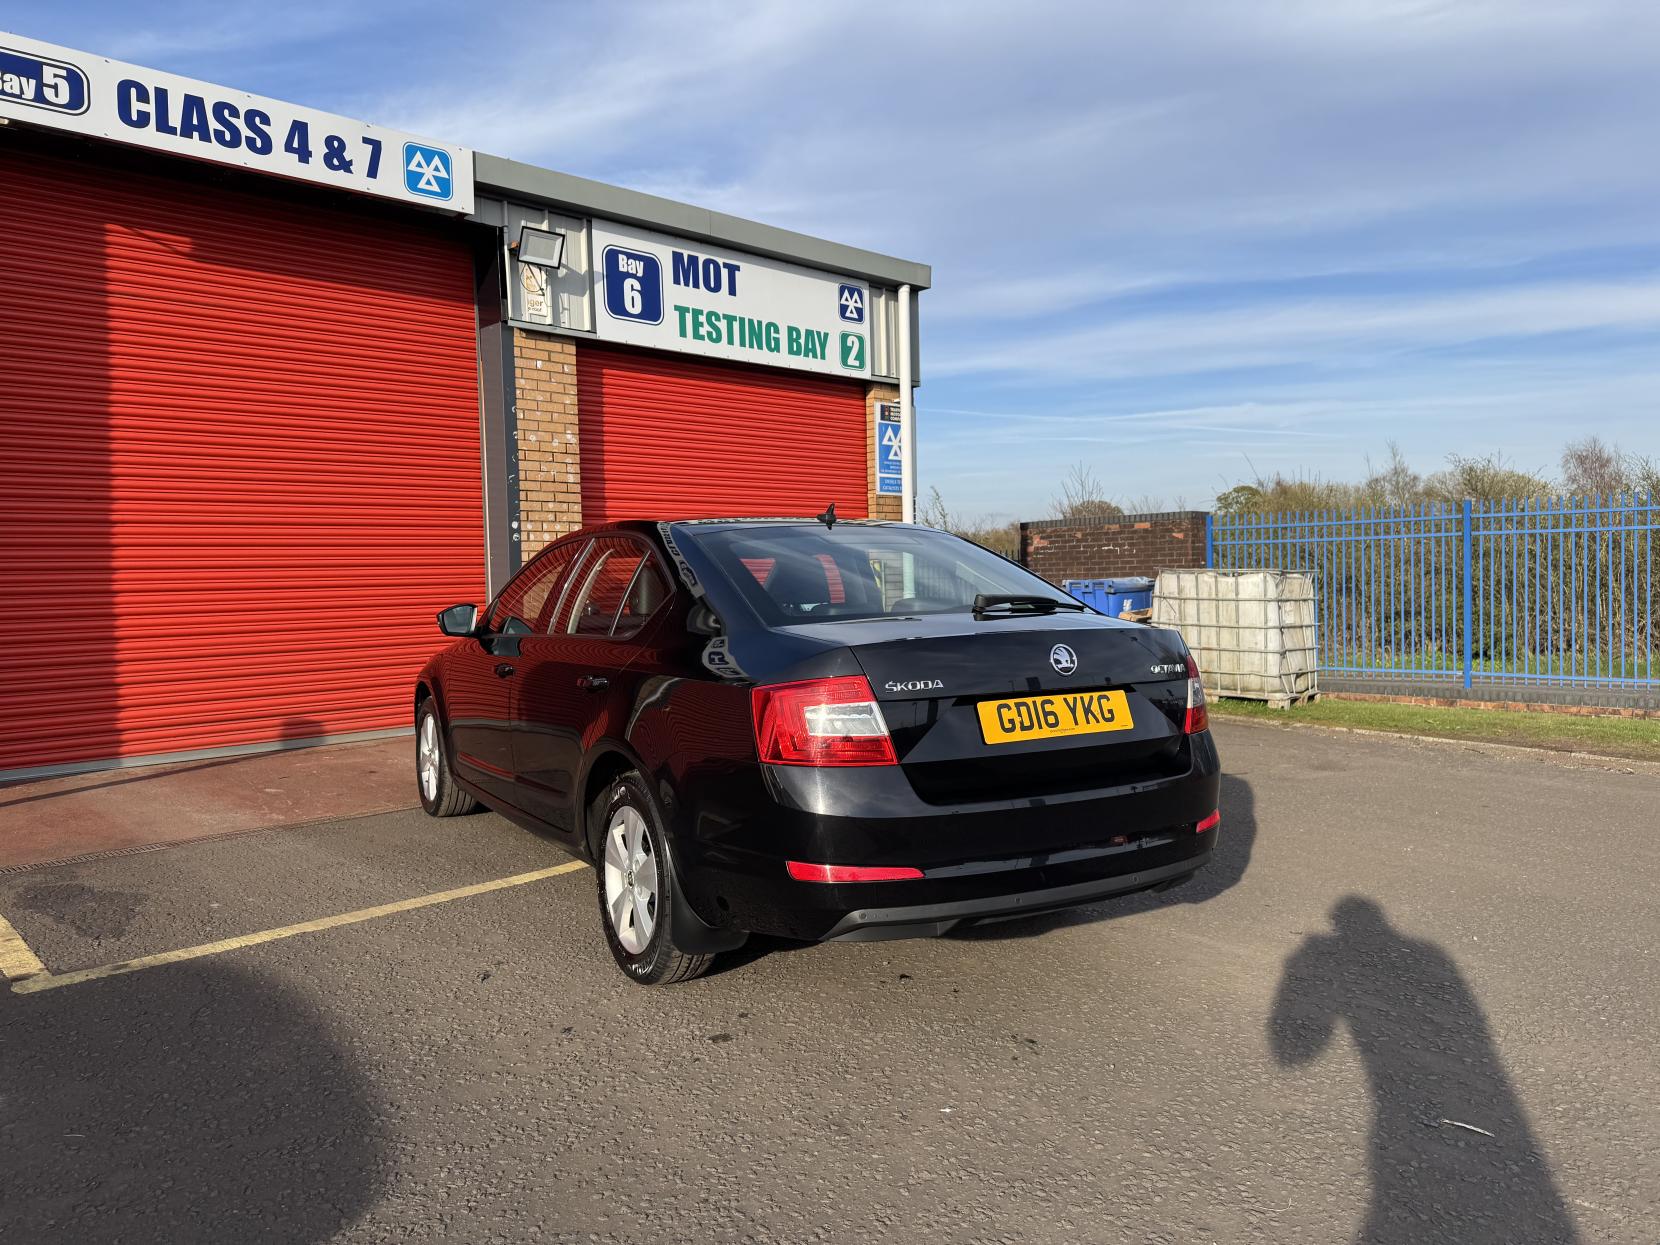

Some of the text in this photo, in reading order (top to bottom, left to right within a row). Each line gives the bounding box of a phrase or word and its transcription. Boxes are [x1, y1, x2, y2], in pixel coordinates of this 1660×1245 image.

[0, 65, 70, 105] ay 5
[117, 79, 382, 179] CLASS 4 & 7
[618, 253, 644, 277] Bay
[671, 250, 741, 297] MOT
[623, 278, 642, 315] 6
[673, 304, 860, 367] TESTING BAY 2
[996, 694, 1115, 734] GD16 YKG
